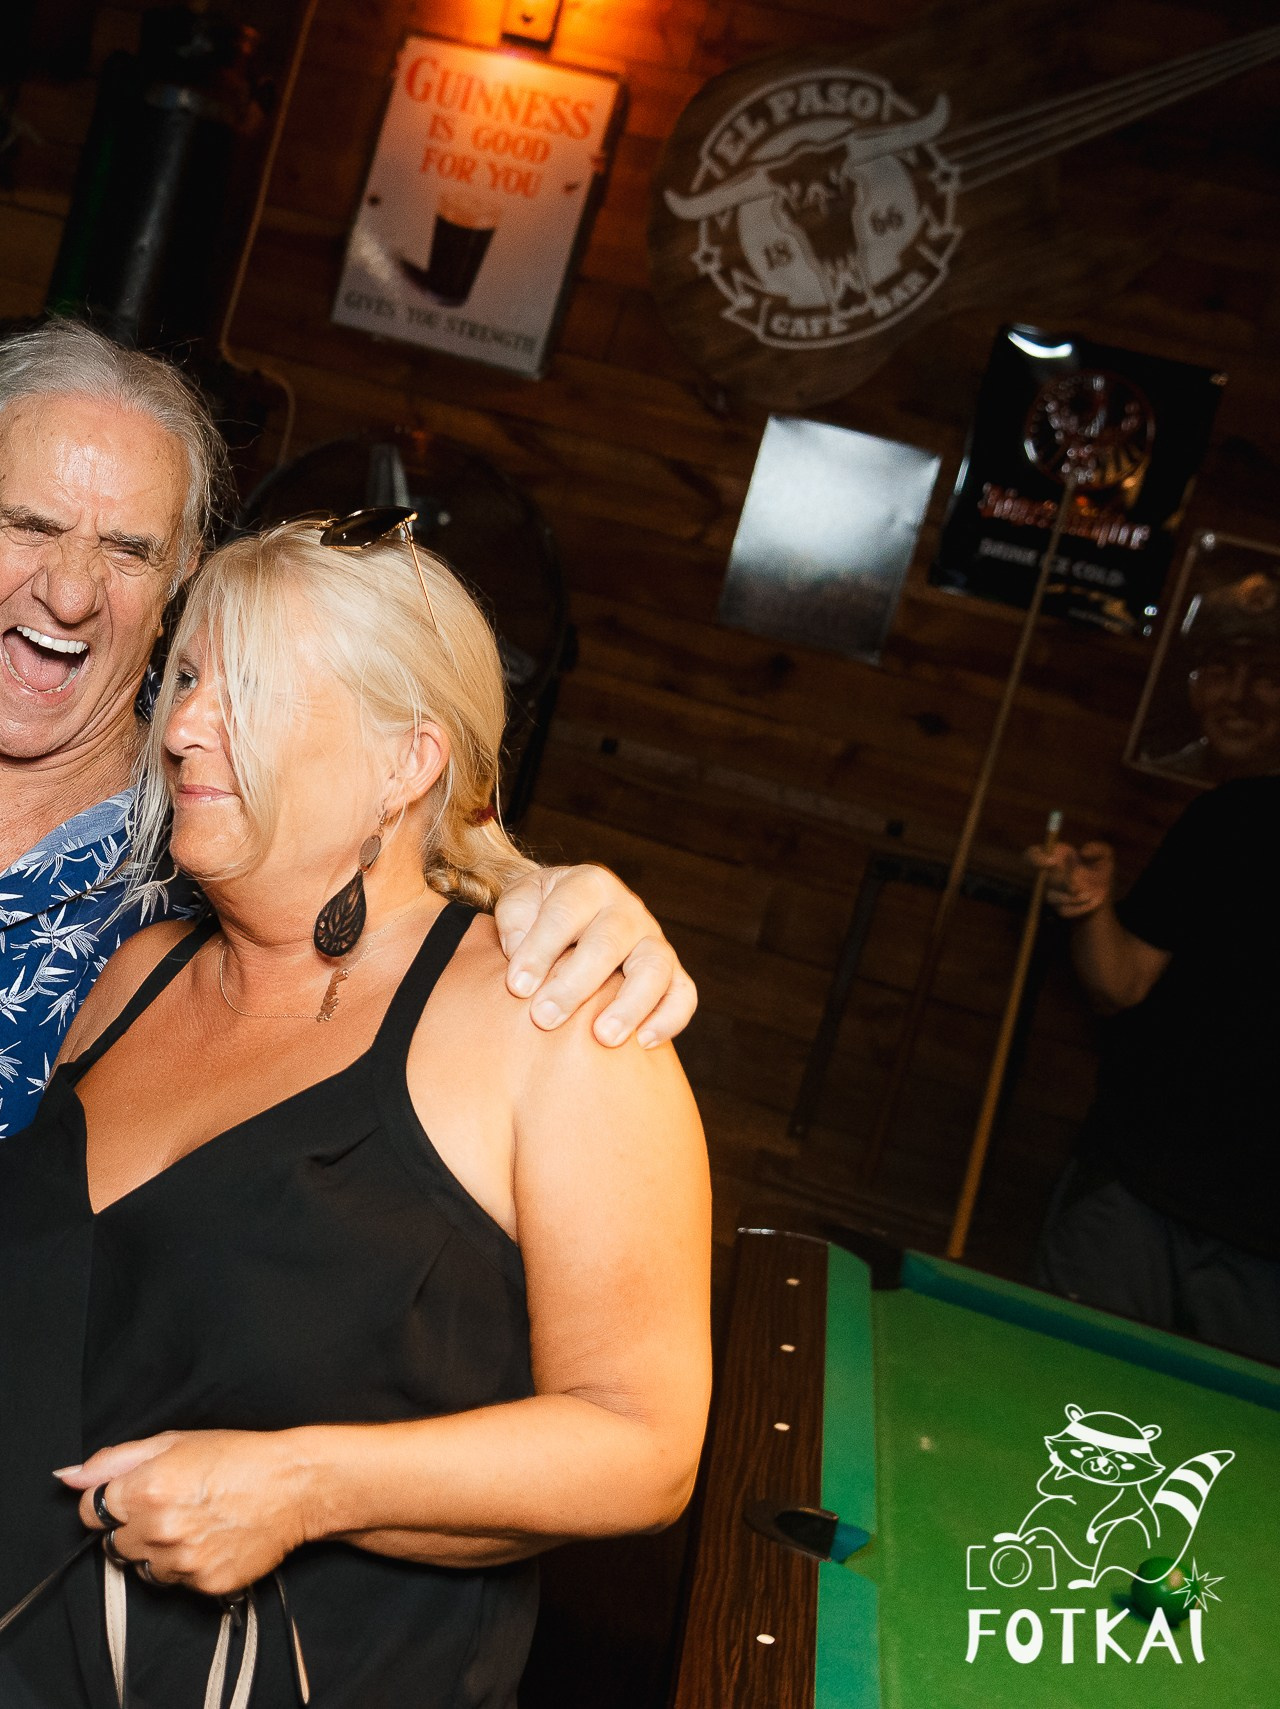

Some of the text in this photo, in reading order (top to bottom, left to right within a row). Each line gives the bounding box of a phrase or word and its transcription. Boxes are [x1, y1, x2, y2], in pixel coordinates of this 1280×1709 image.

[405, 57, 595, 140] GUINNESS
[715, 82, 880, 166] EL PASO
[428, 114, 552, 164] IS GOOD
[421, 147, 542, 198] FOR YOU
[343, 290, 539, 355] GIVES YOU STRENGTH
